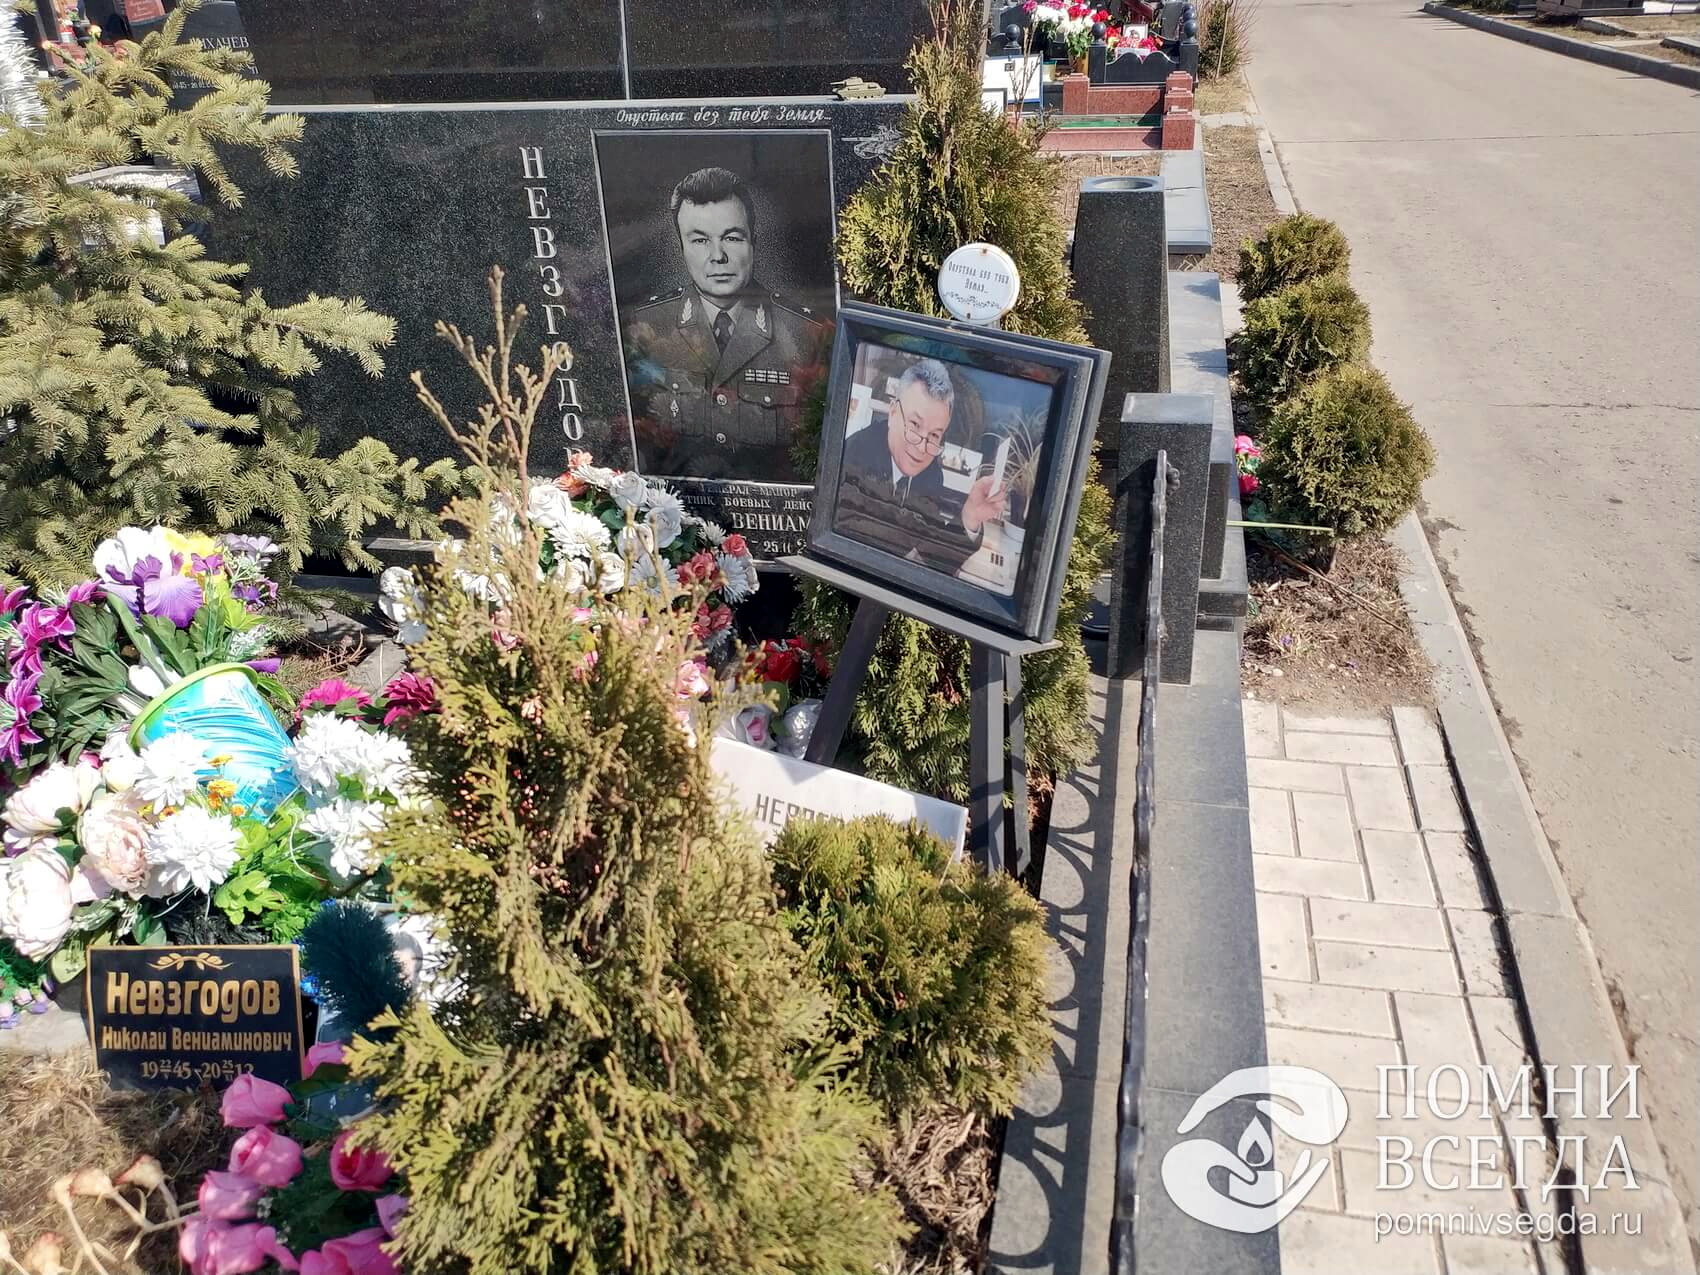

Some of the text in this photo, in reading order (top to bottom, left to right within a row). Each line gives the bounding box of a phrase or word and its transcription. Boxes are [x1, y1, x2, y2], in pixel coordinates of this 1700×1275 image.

[201, 36, 250, 49] ХАЧЕВ
[616, 108, 684, 127] Опустела
[694, 106, 719, 127] без
[728, 106, 769, 124] тебя
[679, 495, 813, 511] СТНИК БОЕВЫХ ДЕЙС
[731, 511, 812, 532] ВЕНИАМ
[106, 971, 281, 1023] Невзгодов
[172, 1026, 292, 1051] Вениаминович
